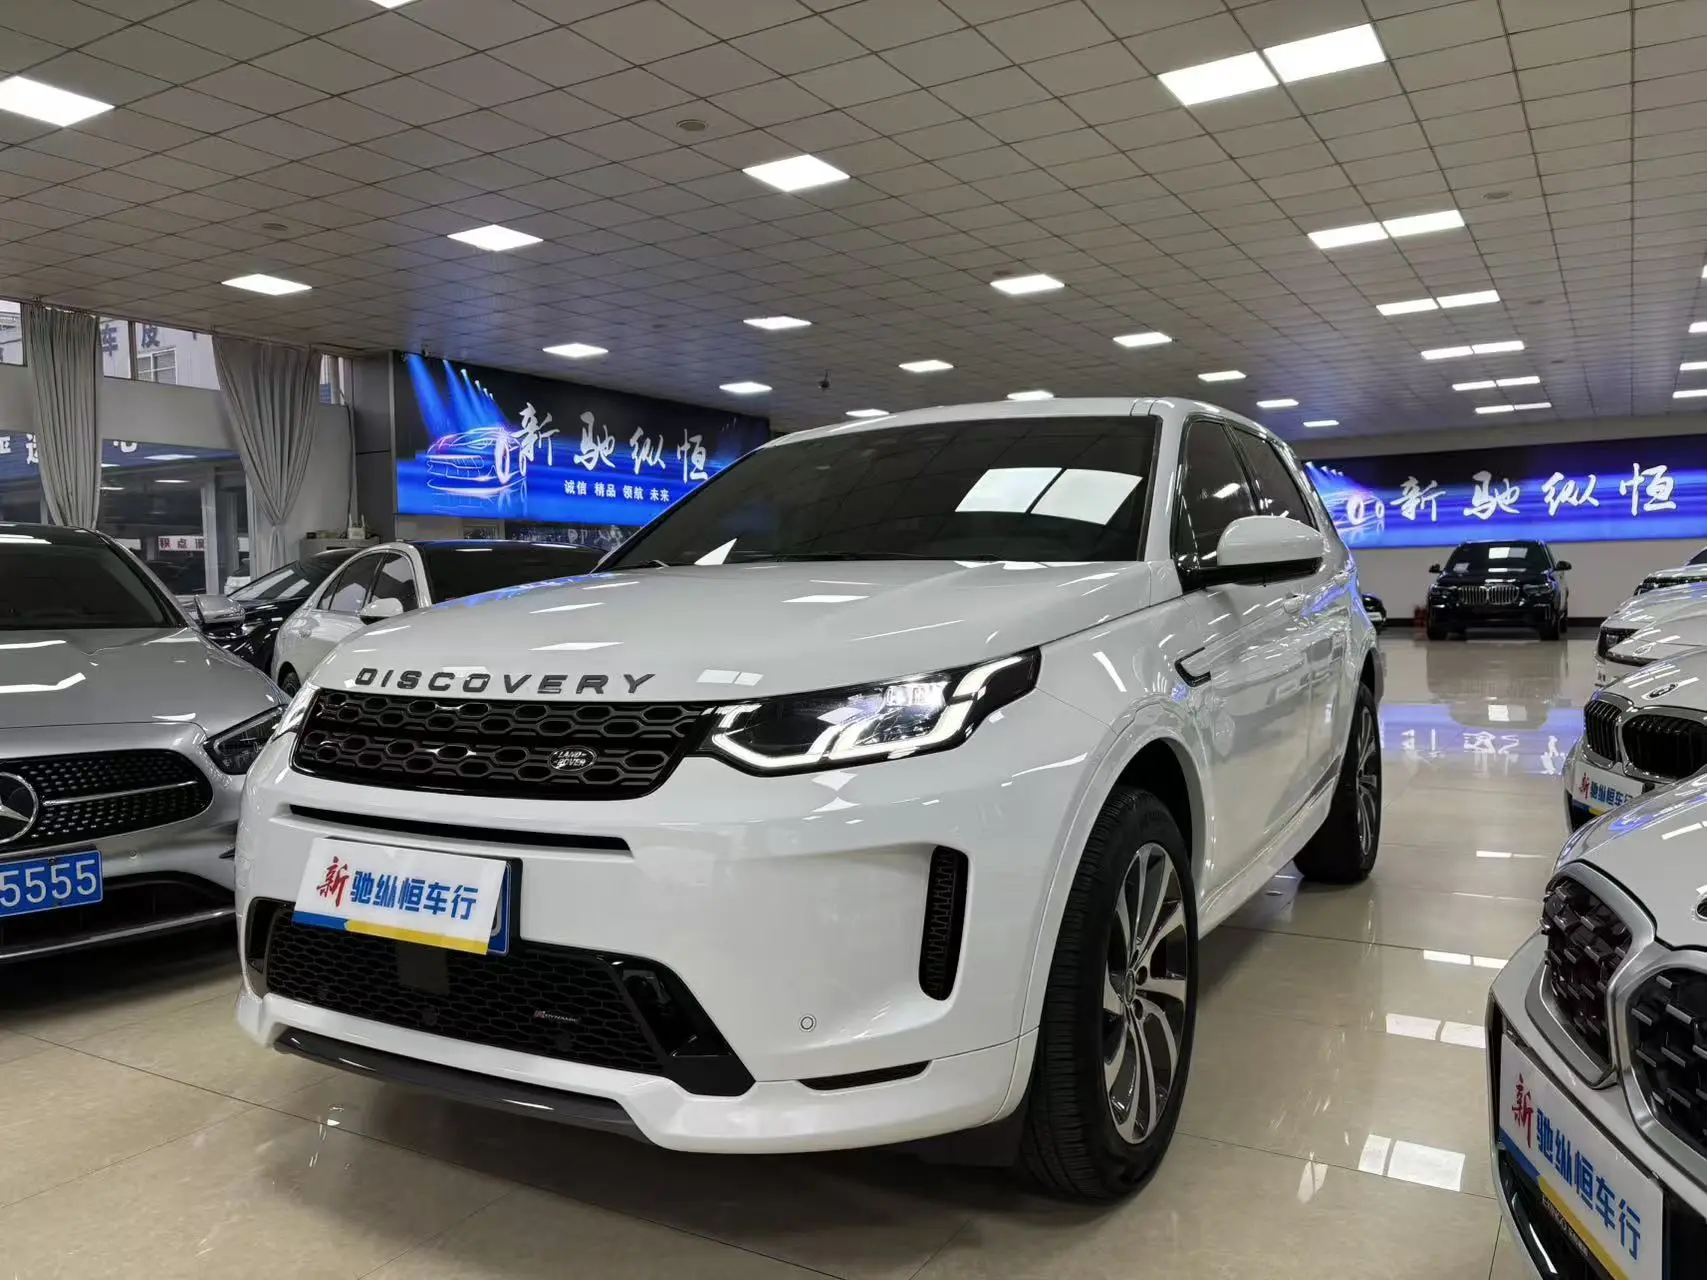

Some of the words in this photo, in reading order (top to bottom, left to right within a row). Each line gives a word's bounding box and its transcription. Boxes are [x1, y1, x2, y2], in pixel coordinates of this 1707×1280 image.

[511, 402, 710, 484] 新驰纵恒
[563, 479, 588, 496] 诚信
[593, 481, 617, 498] 精品
[623, 484, 645, 501] 领航
[649, 487, 671, 502] 未来
[1390, 463, 1677, 522] 新驰纵恒
[355, 667, 656, 695] DISCOVERY
[316, 856, 479, 921] 新驰纵恒车行
[1512, 1073, 1642, 1261] 新驰纵恒车行
